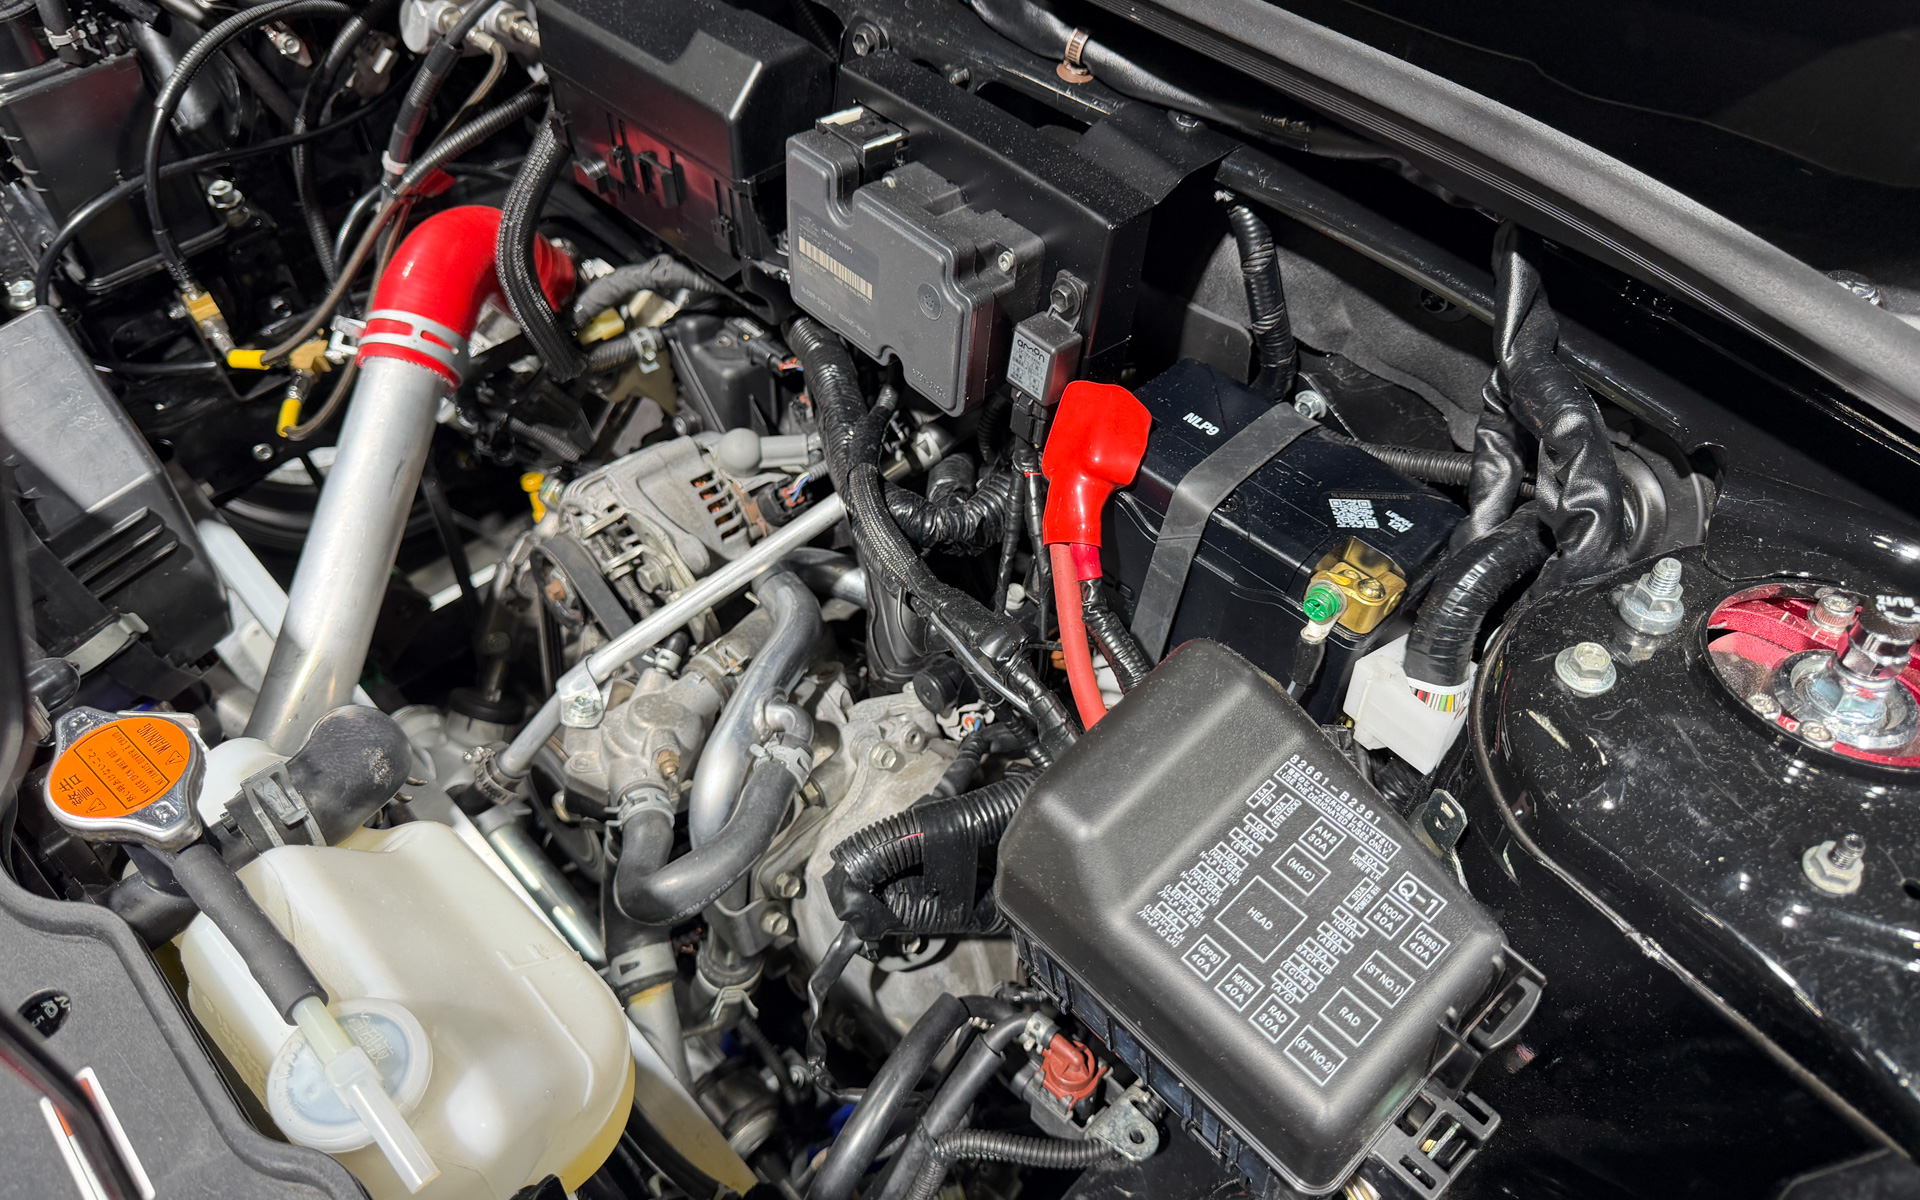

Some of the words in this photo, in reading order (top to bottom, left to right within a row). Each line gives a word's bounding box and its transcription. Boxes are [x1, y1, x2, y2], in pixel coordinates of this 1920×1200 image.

[1017, 339, 1046, 363] amon
[1183, 411, 1219, 437] NLP9
[1388, 518, 1411, 533] 12V
[136, 723, 172, 755] WARNING
[114, 756, 128, 770] WHEN
[124, 768, 139, 781] OPEN
[59, 774, 95, 807] 警告
[134, 779, 151, 794] NEVER
[1254, 787, 1269, 800] 15A
[1289, 753, 1381, 825] 82661-B2361
[1261, 792, 1276, 807] EFI
[1271, 801, 1286, 814] 20A
[1270, 814, 1286, 829] (STR
[1283, 798, 1302, 817] LOCK)
[1294, 781, 1309, 795] THE
[1306, 791, 1348, 825] DESIGNATED
[1346, 821, 1369, 841] FUSES
[1367, 838, 1388, 857] ONLY.
[1242, 823, 1265, 841] STOP
[1251, 820, 1267, 835] 10A
[1313, 825, 1337, 844] AM2
[1230, 839, 1249, 856] (ST)
[1235, 833, 1254, 850] 7.5A
[1307, 833, 1327, 852] 30A
[1207, 848, 1242, 878] (HALOGEN
[1222, 849, 1238, 864] 10A
[1361, 853, 1378, 869] 30A
[1198, 850, 1217, 865] H-LP
[1215, 863, 1227, 875] LO
[1224, 872, 1239, 886] RH)
[1202, 869, 1220, 884] 10A
[1286, 856, 1315, 882] (MGC)
[1348, 853, 1371, 874] POWER
[1369, 870, 1381, 882] LH
[1179, 870, 1198, 886] H-LP
[1195, 884, 1207, 895] LO
[1205, 892, 1219, 906] LH)
[1188, 867, 1222, 898] (HALOGEN
[1183, 888, 1201, 904] 15A
[1351, 886, 1366, 900] 30A
[1353, 893, 1373, 913] POWER
[1369, 885, 1381, 896] RH
[1397, 879, 1438, 915] Q-1
[1162, 909, 1181, 925] 15A
[1176, 905, 1188, 916] LO
[1186, 913, 1201, 927] RH)
[1246, 906, 1273, 930] HEAD
[1340, 913, 1360, 930] 10A
[1372, 911, 1393, 931] 30A
[1379, 902, 1404, 921] ROOF
[1155, 925, 1168, 937] LO
[1164, 934, 1180, 948] LH)
[1325, 929, 1344, 945] 30A
[1331, 917, 1357, 939] HORN
[1316, 932, 1342, 955] (ABS)
[1409, 941, 1430, 960] 40A
[1414, 930, 1441, 953] (ABS)
[1190, 953, 1210, 972] 40A
[1197, 942, 1221, 964] (EPS)
[1294, 943, 1319, 966] BACK
[1318, 962, 1332, 975] UP
[1310, 945, 1329, 961] 15A
[1297, 963, 1310, 976] 5A
[1363, 961, 1382, 977] (ST
[1377, 972, 1404, 997] NO.1)
[1224, 983, 1244, 1002] 40A
[1231, 972, 1254, 994] HEATER
[1270, 981, 1296, 1004] (A/C)
[1280, 977, 1299, 994] 10A
[1257, 1012, 1279, 1034] 30A
[1267, 1004, 1287, 1023] RAD
[1338, 1005, 1361, 1026] RAD
[1294, 1036, 1314, 1053] (ST
[1309, 1049, 1335, 1074] NO.2)
